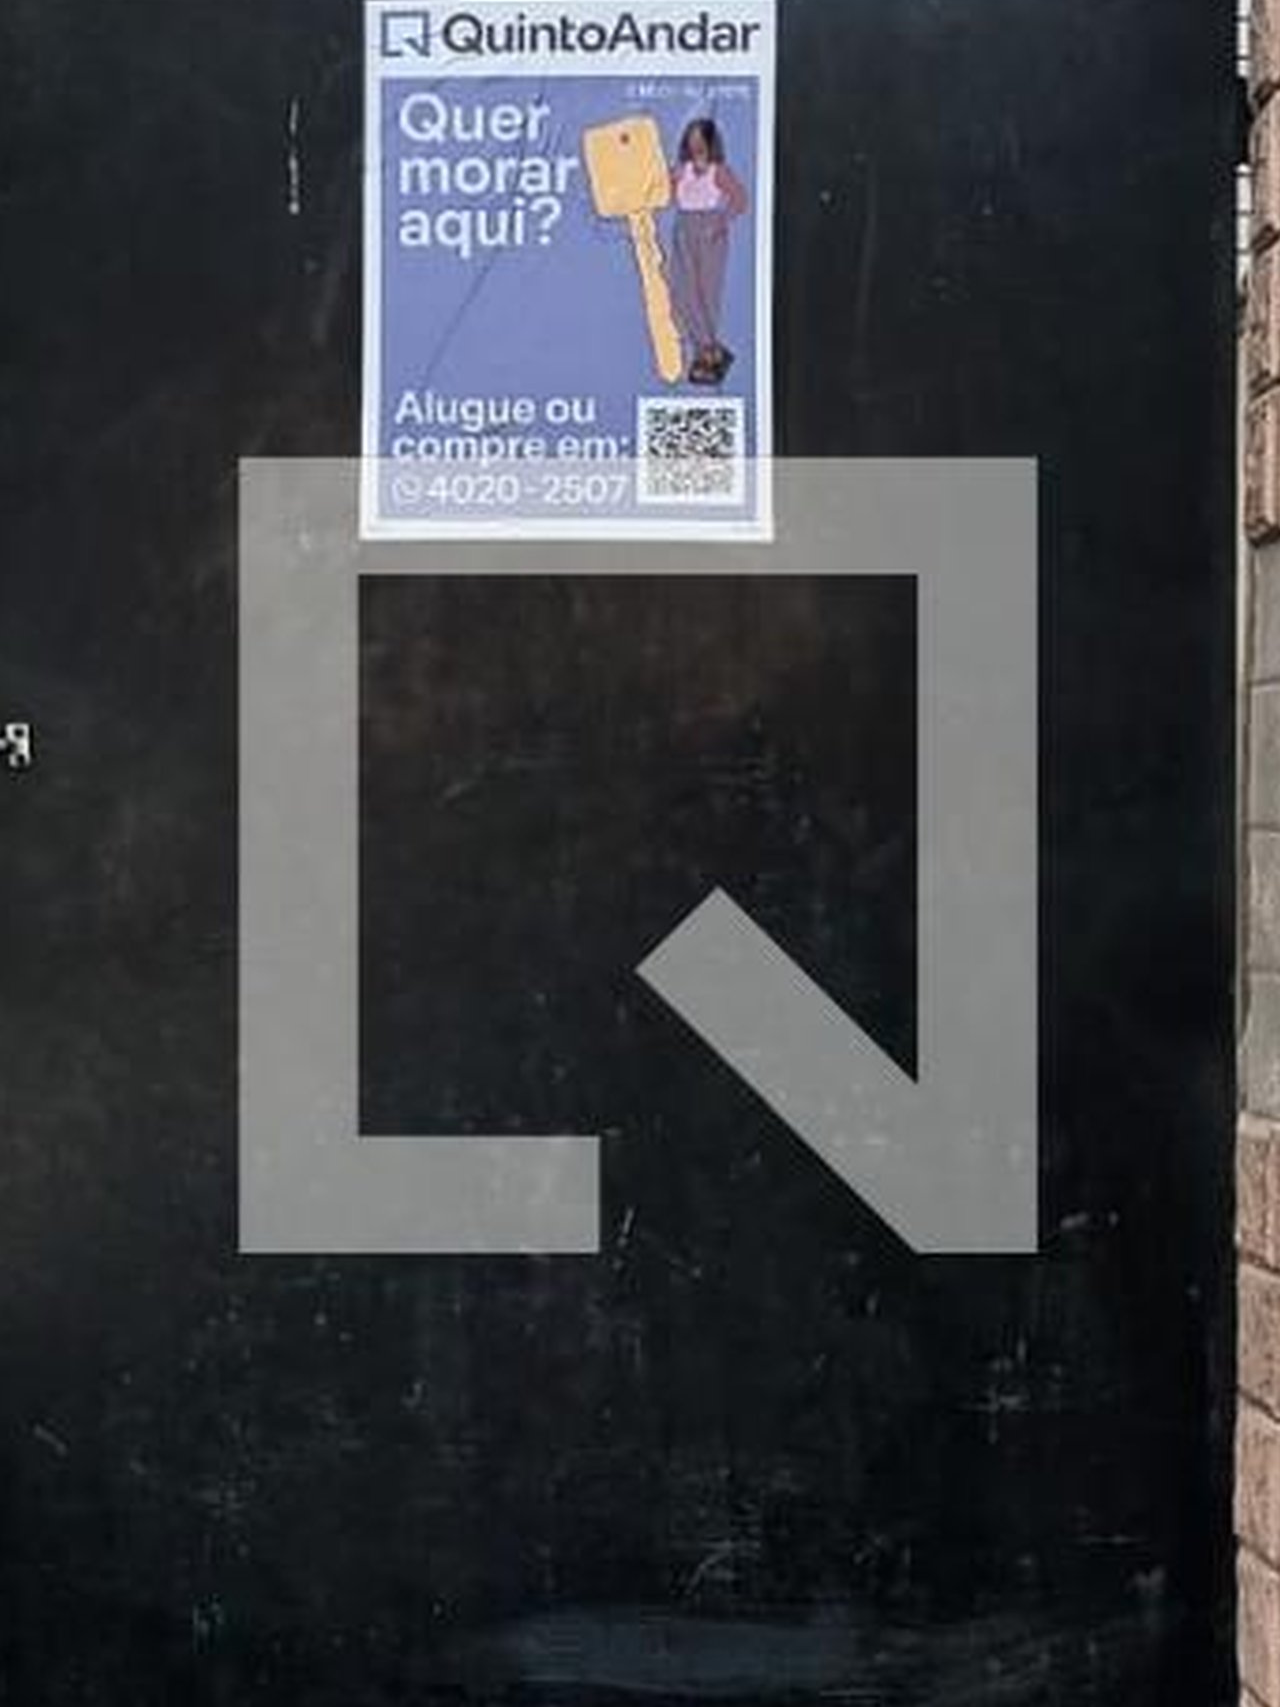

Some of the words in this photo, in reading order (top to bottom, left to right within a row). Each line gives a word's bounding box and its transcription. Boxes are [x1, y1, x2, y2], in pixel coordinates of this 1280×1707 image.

[442, 10, 761, 56] QuintoAndar
[397, 90, 551, 143] Quer
[398, 155, 580, 195] morar
[398, 197, 562, 258] aqui?
[394, 389, 537, 433] Alugue
[544, 396, 597, 424] ou
[391, 434, 547, 468] compre
[557, 434, 631, 462] em:
[426, 474, 629, 505] 4020-2507
